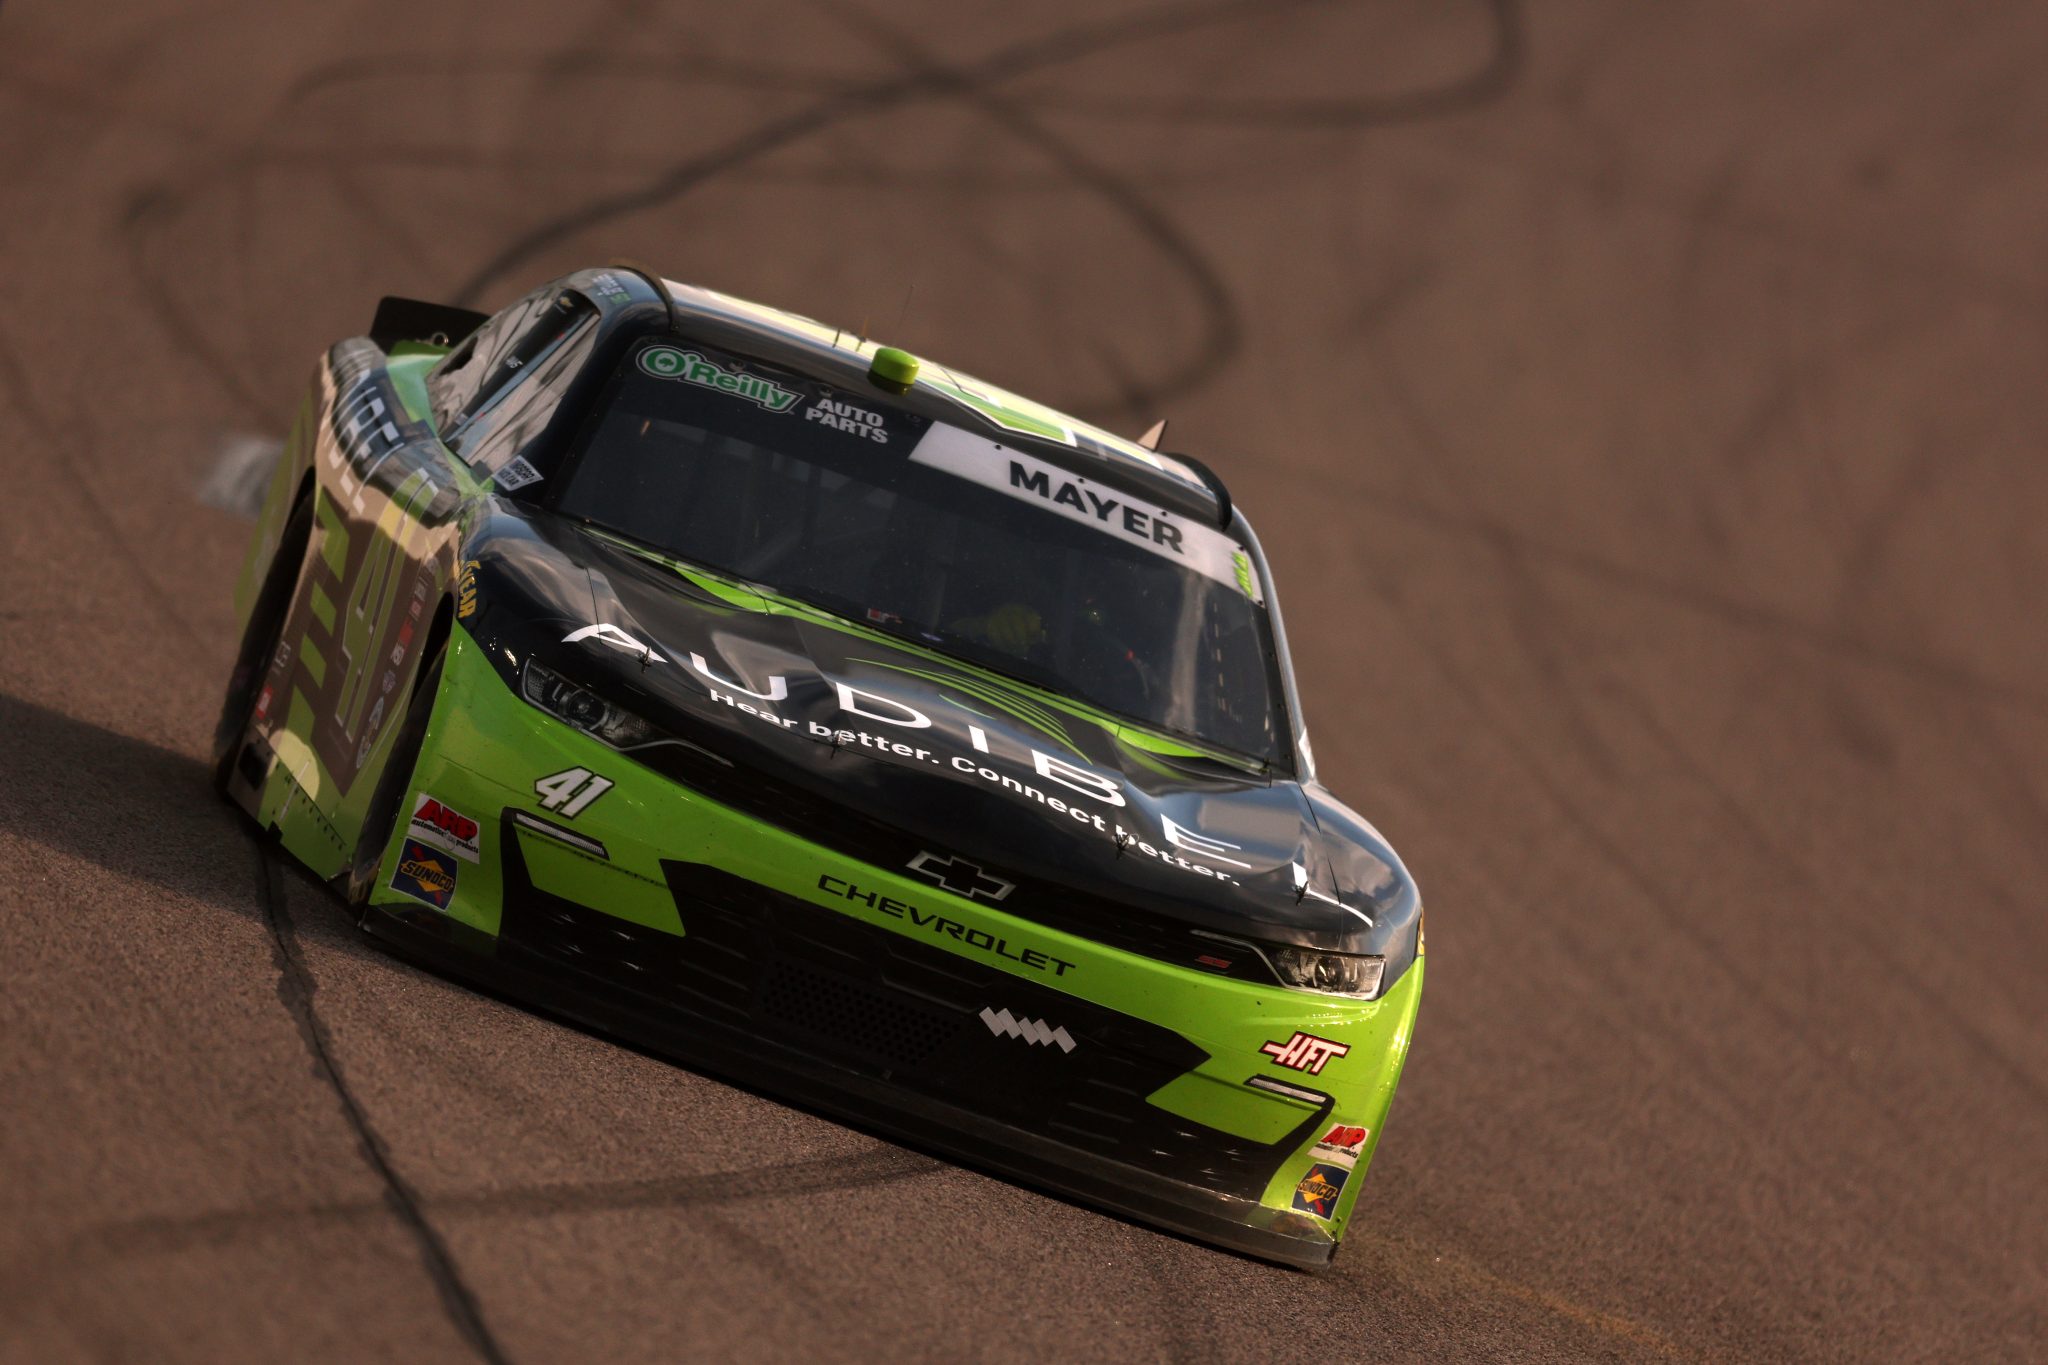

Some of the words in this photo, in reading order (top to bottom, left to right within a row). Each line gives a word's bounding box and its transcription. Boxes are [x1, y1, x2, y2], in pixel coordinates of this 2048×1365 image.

[643, 347, 795, 410] O'Reilly
[805, 407, 889, 444] PARTS
[816, 398, 884, 428] AUTO
[1009, 460, 1185, 554] MAYER
[561, 623, 1373, 927] AUDIBEL
[709, 688, 798, 729] Hear
[808, 721, 940, 764] better.
[951, 756, 1106, 832] Connect
[415, 798, 478, 841] ARP
[534, 766, 615, 820] 41
[402, 861, 454, 892] SUNOCO
[817, 874, 1076, 976] CHEVROLET
